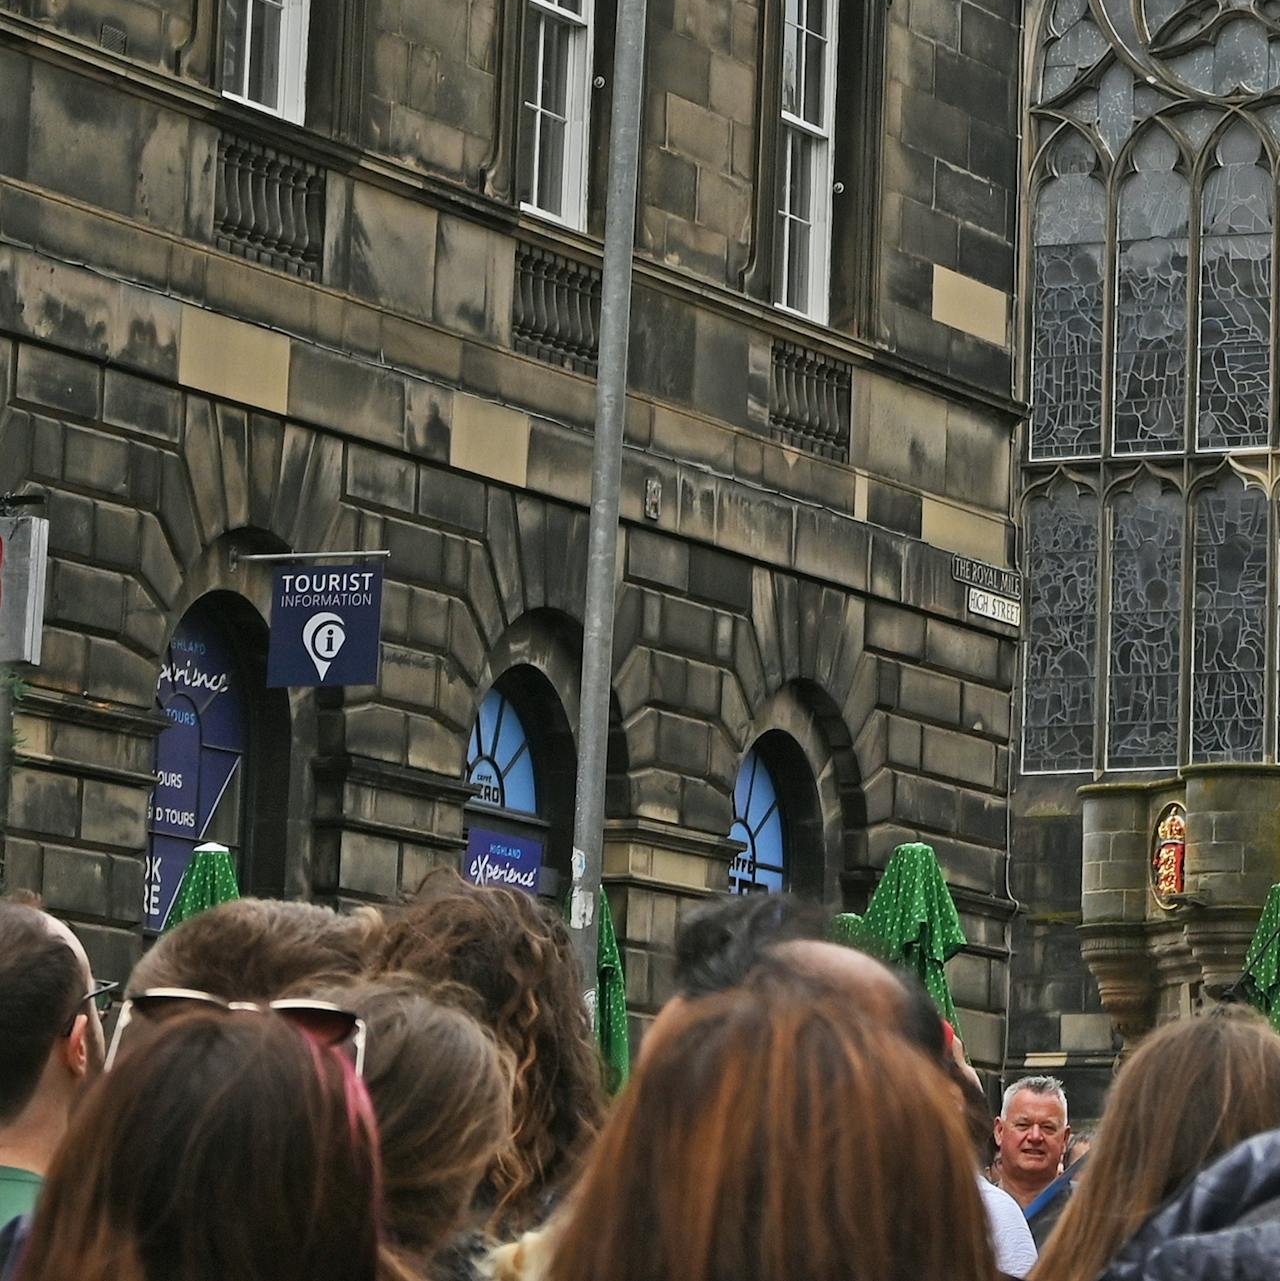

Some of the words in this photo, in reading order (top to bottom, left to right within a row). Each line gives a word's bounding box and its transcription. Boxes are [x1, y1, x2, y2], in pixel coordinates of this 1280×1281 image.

[281, 572, 374, 593] TOURIST
[954, 557, 971, 579] THE
[972, 561, 998, 589] ROYAL
[1000, 572, 1020, 595] MILE
[280, 593, 372, 608] INFORMATION
[970, 590, 989, 612] HIGH
[992, 598, 1020, 624] STREET
[166, 707, 196, 726] TOURS
[165, 808, 195, 828] TOURS
[489, 843, 521, 859] HIGHLAND
